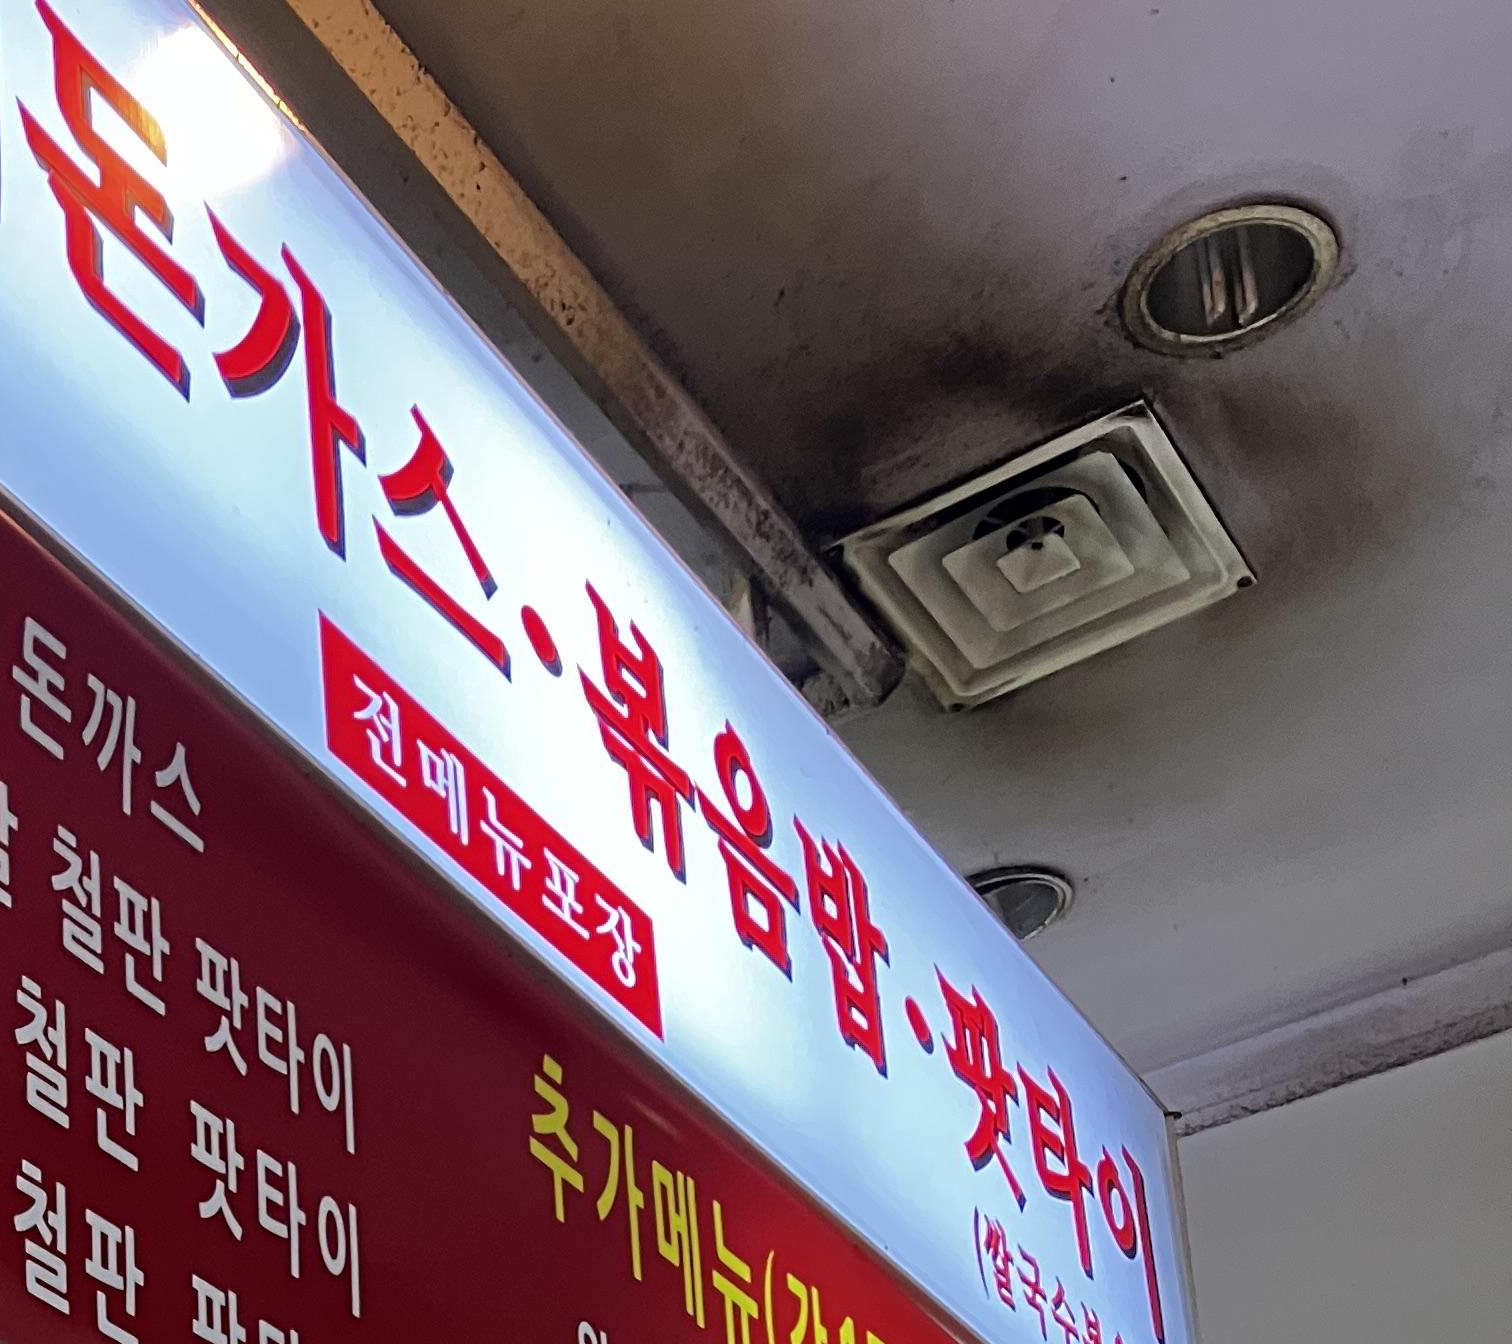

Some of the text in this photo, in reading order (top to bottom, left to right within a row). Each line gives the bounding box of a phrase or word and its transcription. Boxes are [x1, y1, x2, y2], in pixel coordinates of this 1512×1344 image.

[13, 616, 204, 853] 돈까스
[16, 975, 144, 1171] 철판
[190, 1098, 361, 1318] 팟타이
[52, 823, 171, 1015] 철판
[194, 937, 356, 1154] 팟타이
